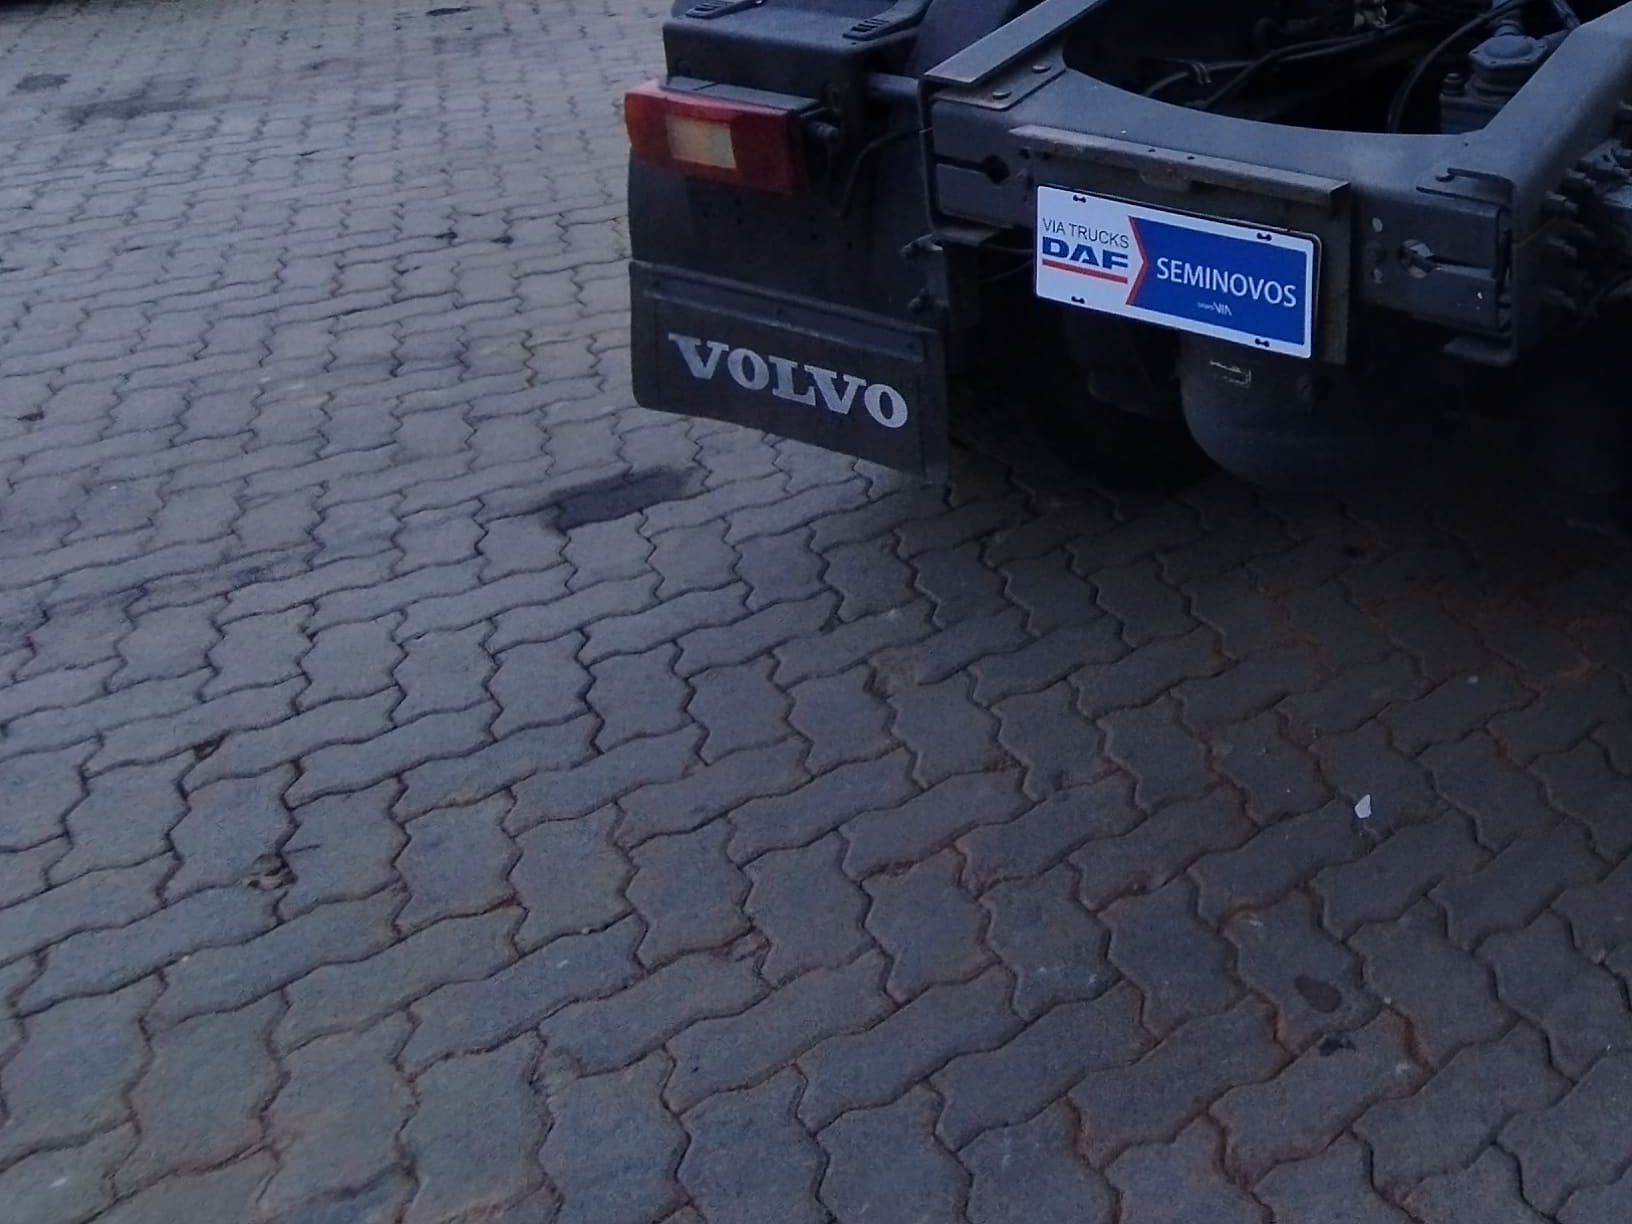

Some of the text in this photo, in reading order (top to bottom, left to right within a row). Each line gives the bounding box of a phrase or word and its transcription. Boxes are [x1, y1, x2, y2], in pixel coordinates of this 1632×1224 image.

[1042, 217, 1130, 250] VIA TRUCKS
[1042, 236, 1129, 269] DAF
[1156, 256, 1298, 308] SEMINOVOS
[668, 332, 909, 429] VOLVO
